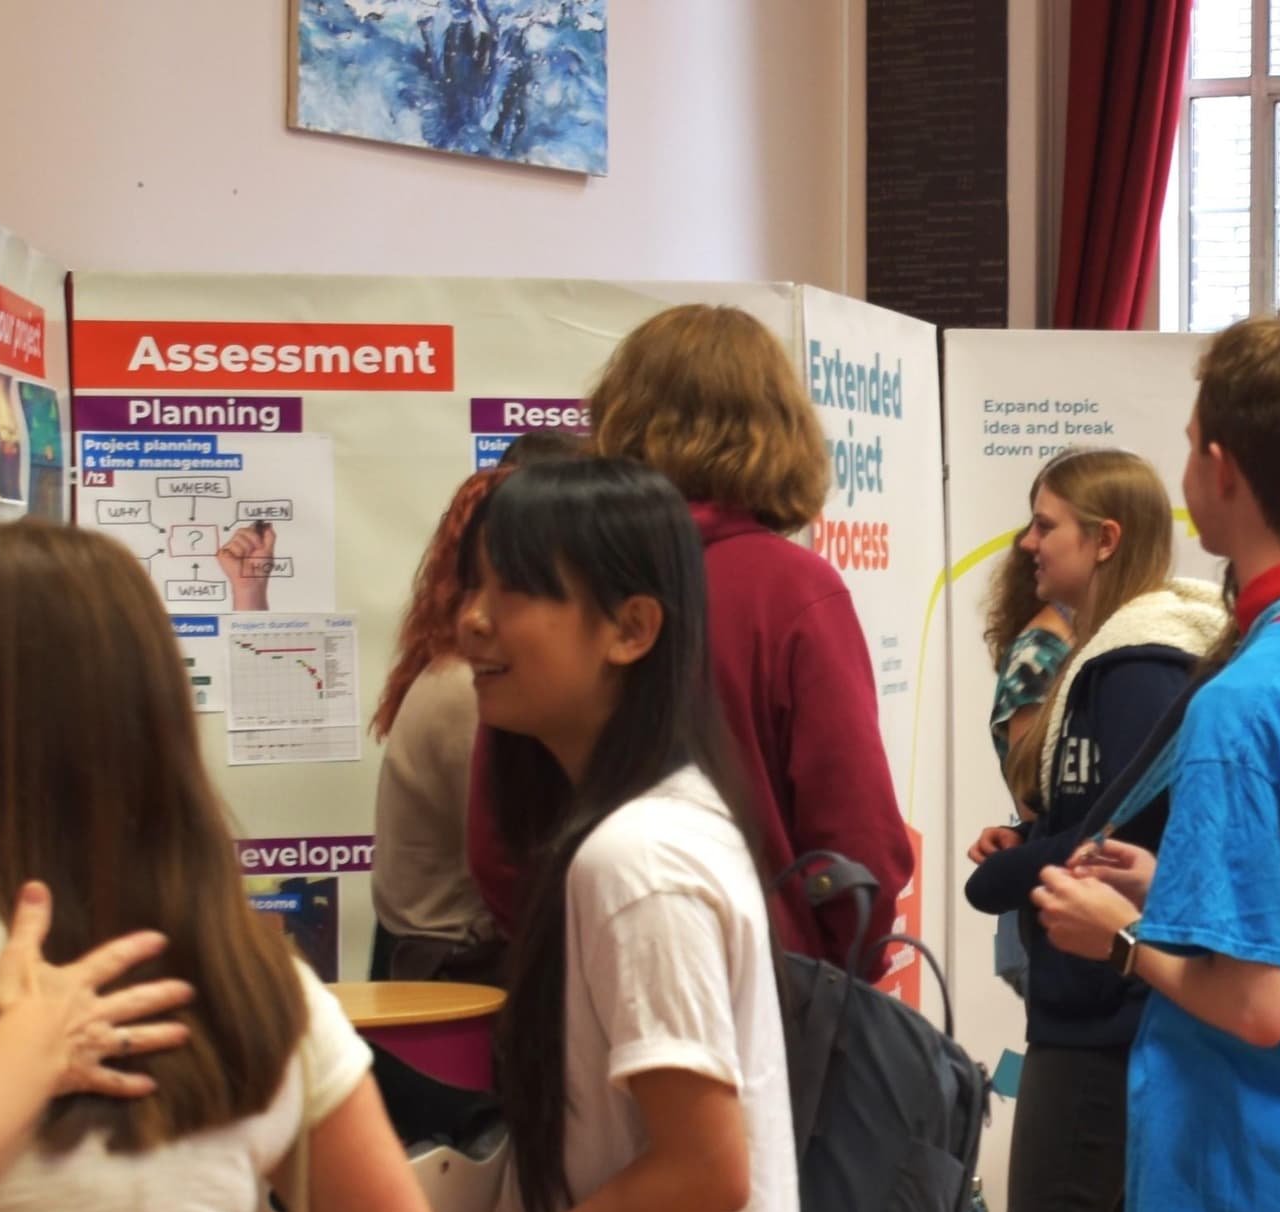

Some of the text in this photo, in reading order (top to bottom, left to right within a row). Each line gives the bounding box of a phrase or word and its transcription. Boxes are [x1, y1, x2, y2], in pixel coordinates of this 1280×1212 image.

[128, 335, 436, 376] Assessment
[809, 339, 903, 420] Extended
[983, 398, 1100, 416] Expand topic
[128, 399, 281, 433] Planning
[983, 420, 1115, 435] idea and break
[84, 439, 212, 454] Project planning
[983, 443, 1033, 456] down
[85, 456, 241, 470] & time management
[170, 482, 223, 495] WHERE
[107, 505, 289, 518] WHY WHEN
[249, 562, 288, 575] HOW
[177, 584, 219, 597] WHAT
[235, 840, 377, 872] evelopm
